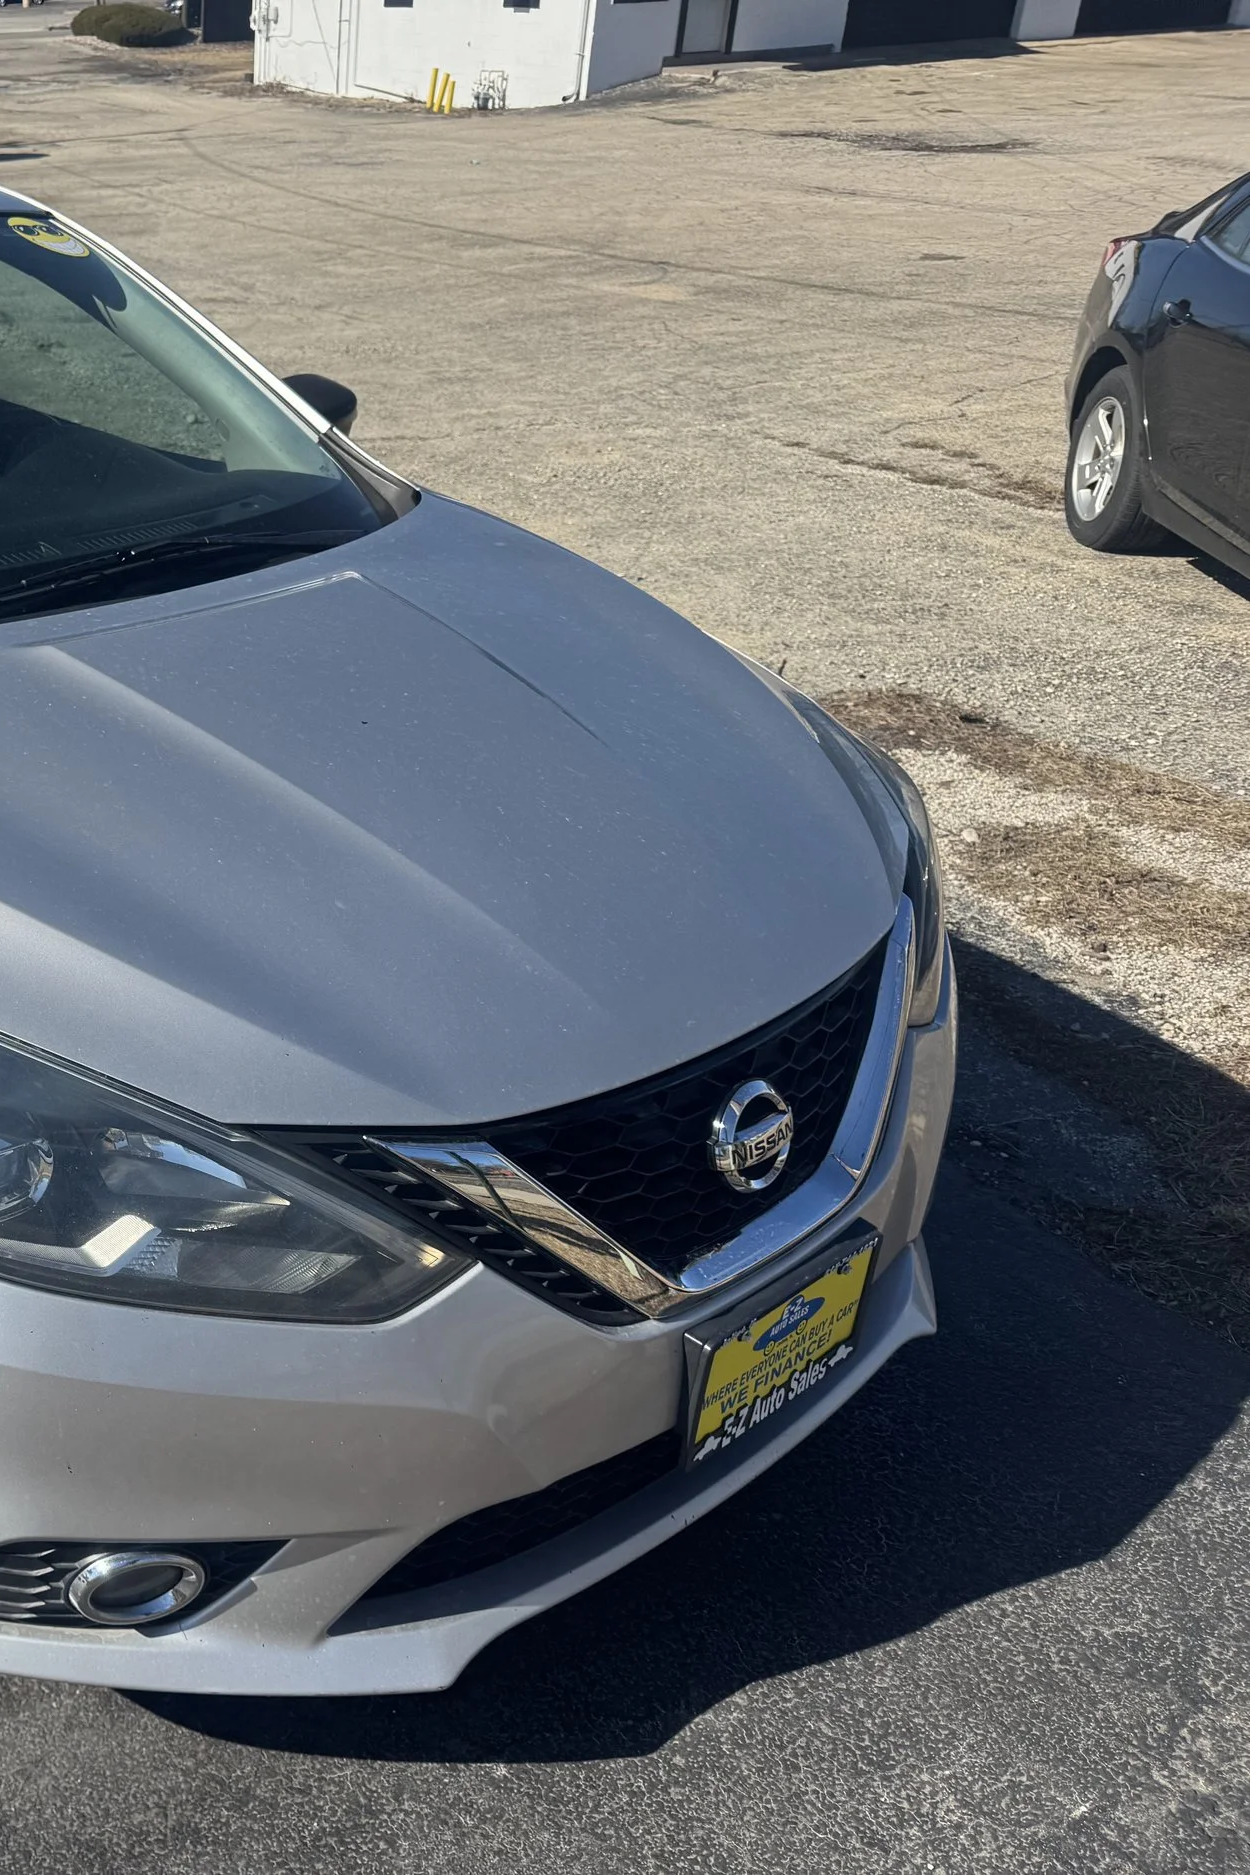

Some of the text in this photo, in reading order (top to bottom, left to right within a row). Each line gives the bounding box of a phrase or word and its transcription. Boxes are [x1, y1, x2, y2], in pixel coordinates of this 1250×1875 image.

[732, 1122, 793, 1166] NISSAN
[770, 1319, 788, 1338] AUTO
[789, 1304, 810, 1325] SALES
[782, 1296, 804, 1321] E-Z
[701, 1379, 738, 1411] WHERE
[739, 1344, 788, 1387] EVERYONE
[789, 1331, 810, 1354] CAN
[808, 1316, 828, 1341] BUY
[827, 1314, 834, 1327] A
[720, 1387, 750, 1414] WE
[753, 1329, 833, 1393] FINANCE!
[721, 1357, 828, 1448] E-Z Auto Sales
